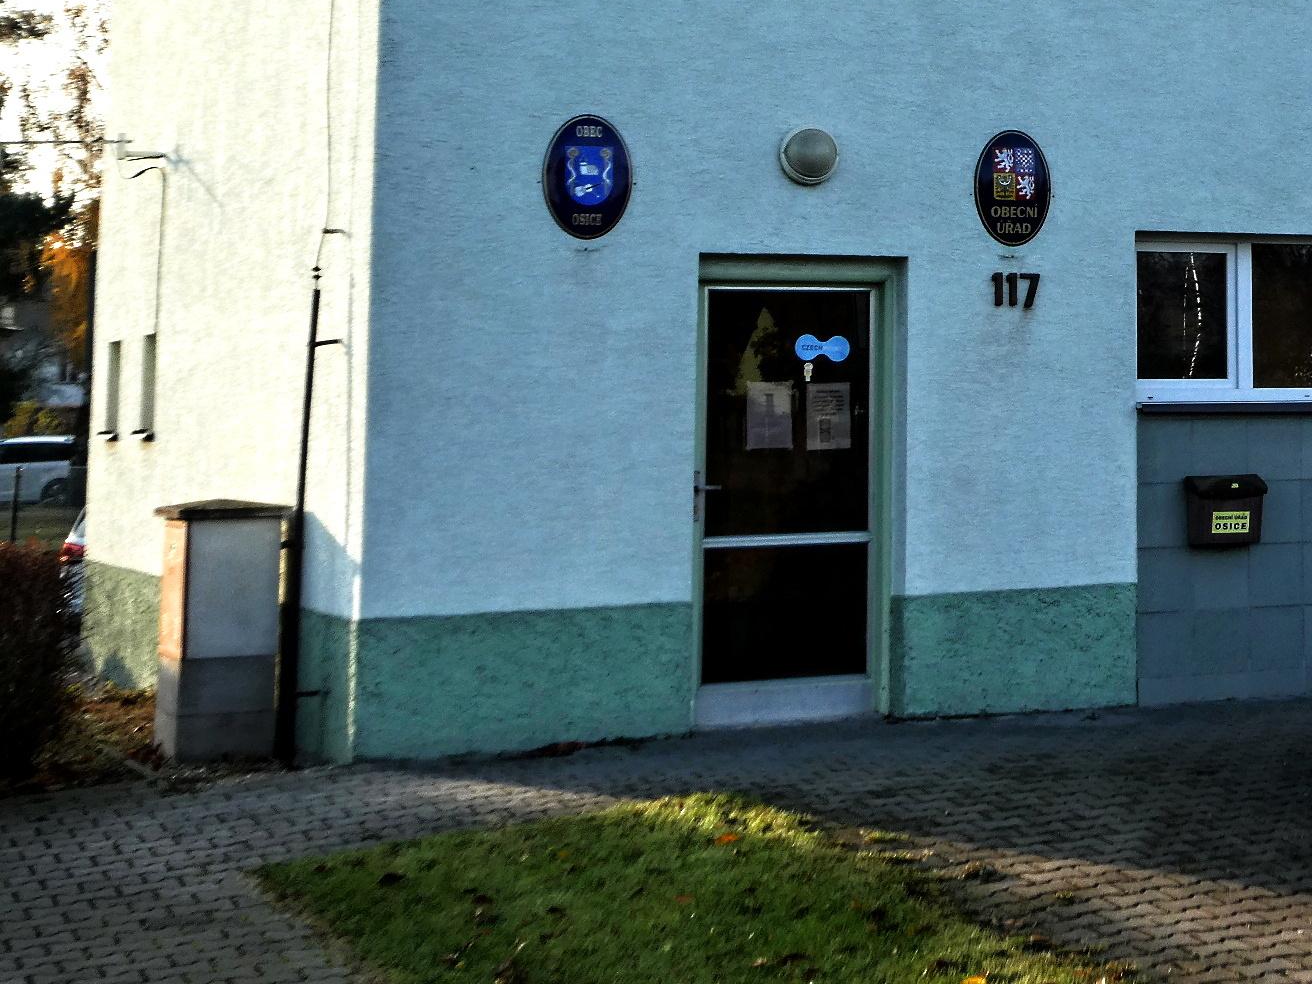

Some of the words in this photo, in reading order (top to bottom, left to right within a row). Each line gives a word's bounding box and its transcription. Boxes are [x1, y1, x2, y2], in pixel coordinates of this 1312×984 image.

[576, 125, 602, 137] OBEC
[991, 203, 1038, 218] OBECNÍ
[572, 214, 602, 226] OSICE
[997, 219, 1031, 234] ÚŘAD
[991, 272, 1041, 308] 117
[1215, 522, 1247, 530] OSICE
